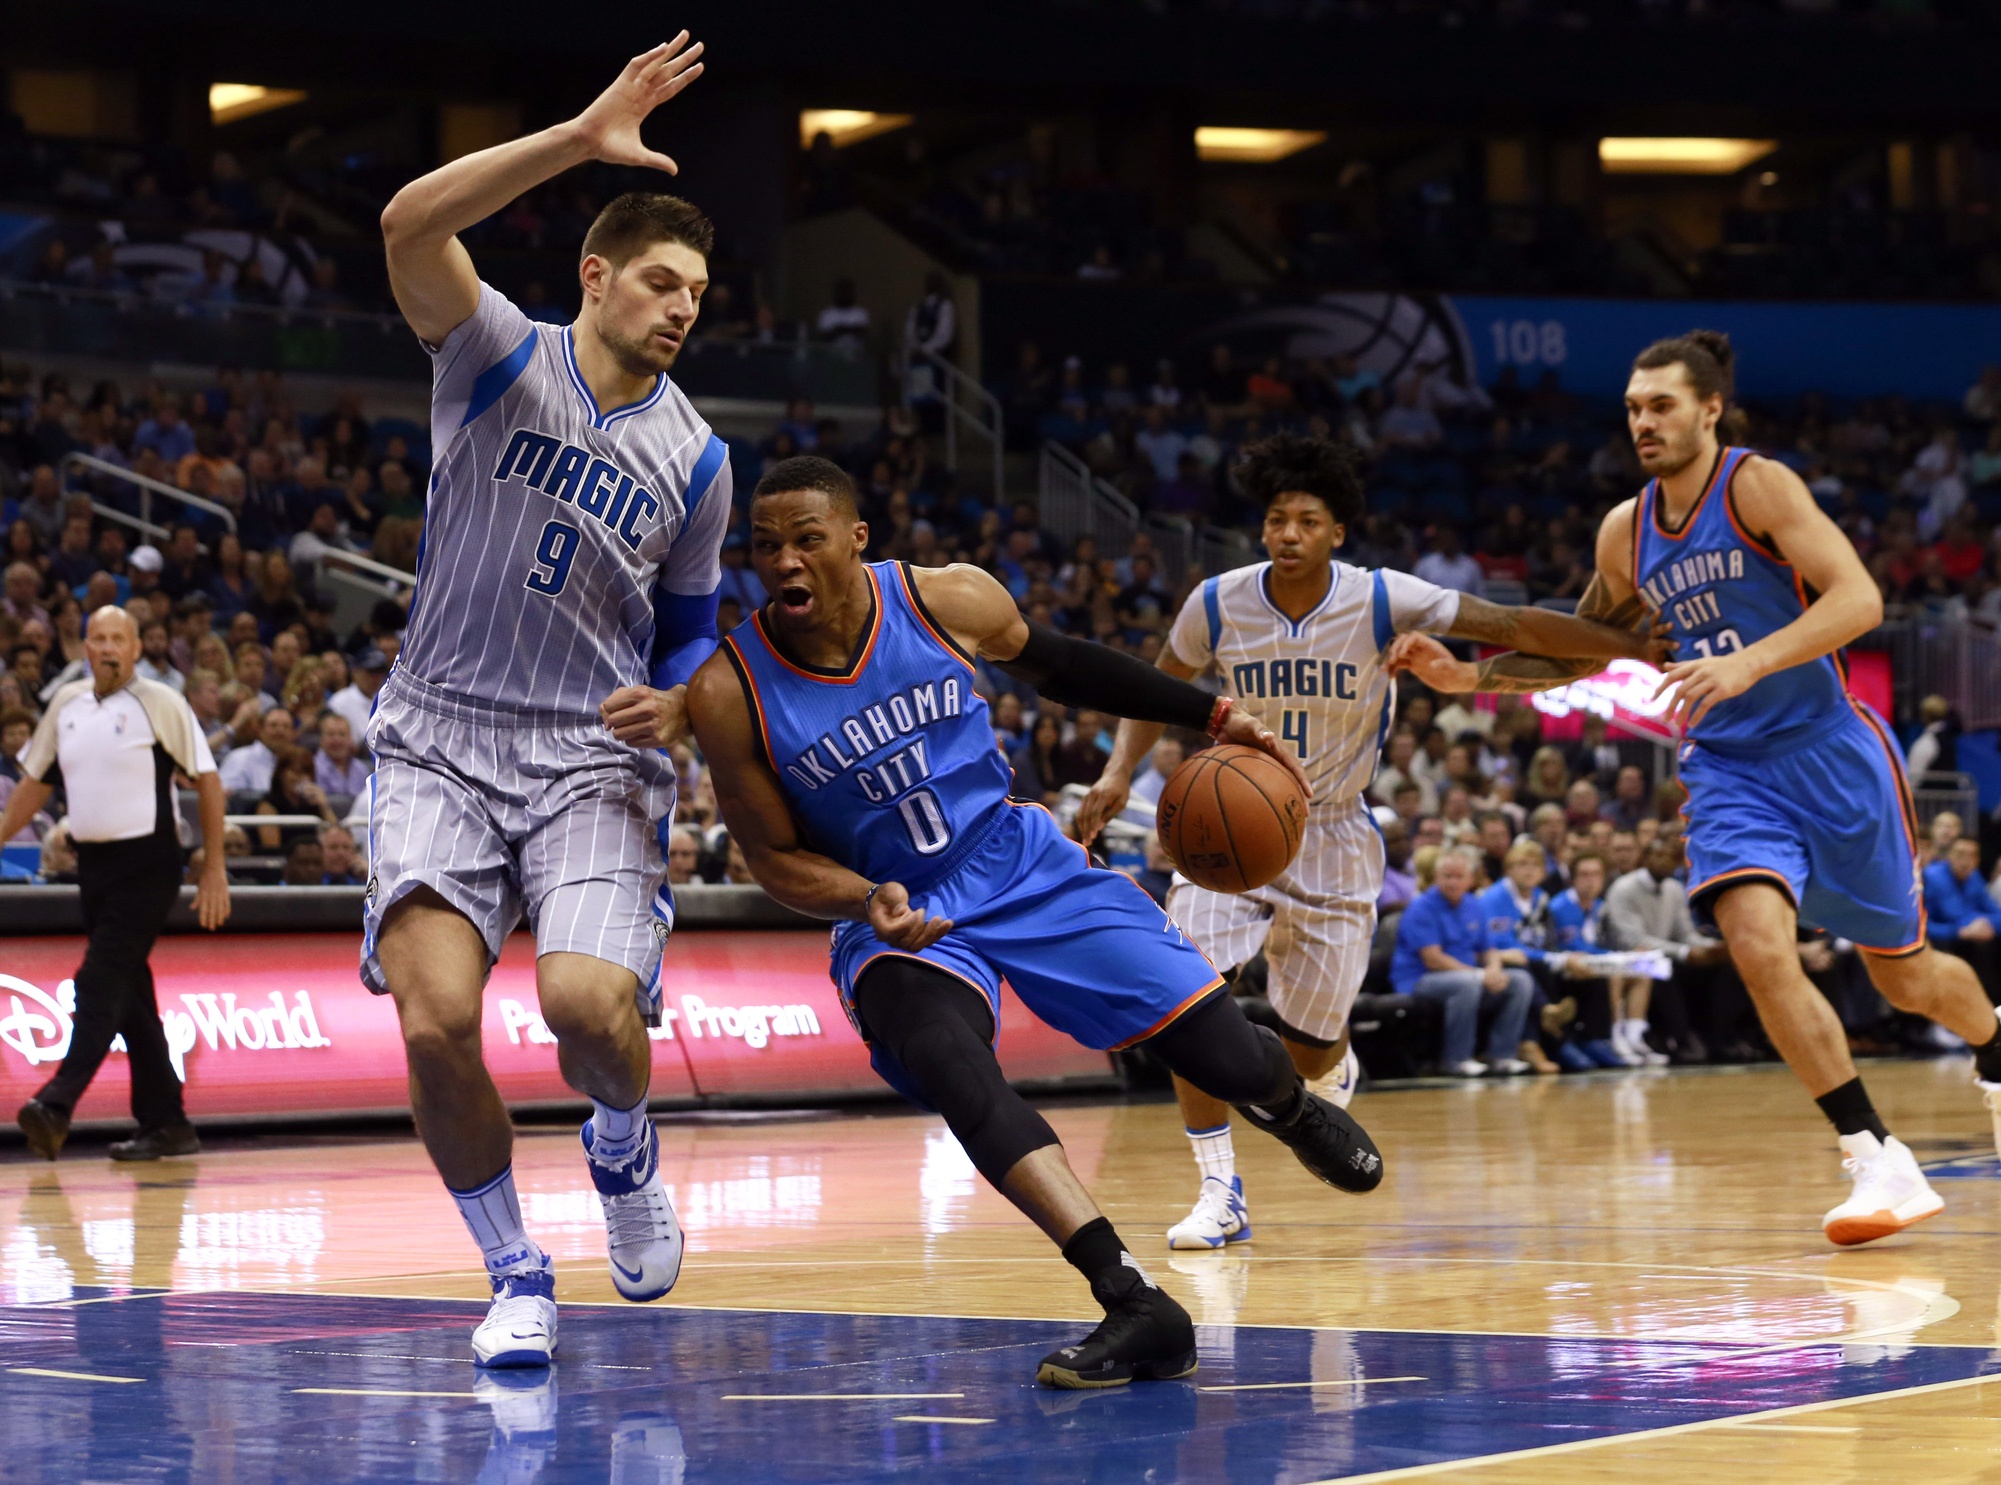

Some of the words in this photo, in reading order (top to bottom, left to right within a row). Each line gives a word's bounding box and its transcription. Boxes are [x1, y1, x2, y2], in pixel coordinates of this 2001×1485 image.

[1491, 320, 1568, 364] 108
[491, 427, 660, 554] MAGIC
[523, 518, 583, 598] 9
[1673, 591, 1721, 630] CITY
[1232, 657, 1358, 700] MAGIC
[785, 675, 963, 792] OKLAHOMA
[1280, 708, 1310, 760] 4
[855, 737, 931, 804] CITY
[898, 787, 952, 857] 0
[680, 994, 822, 1049] Program
